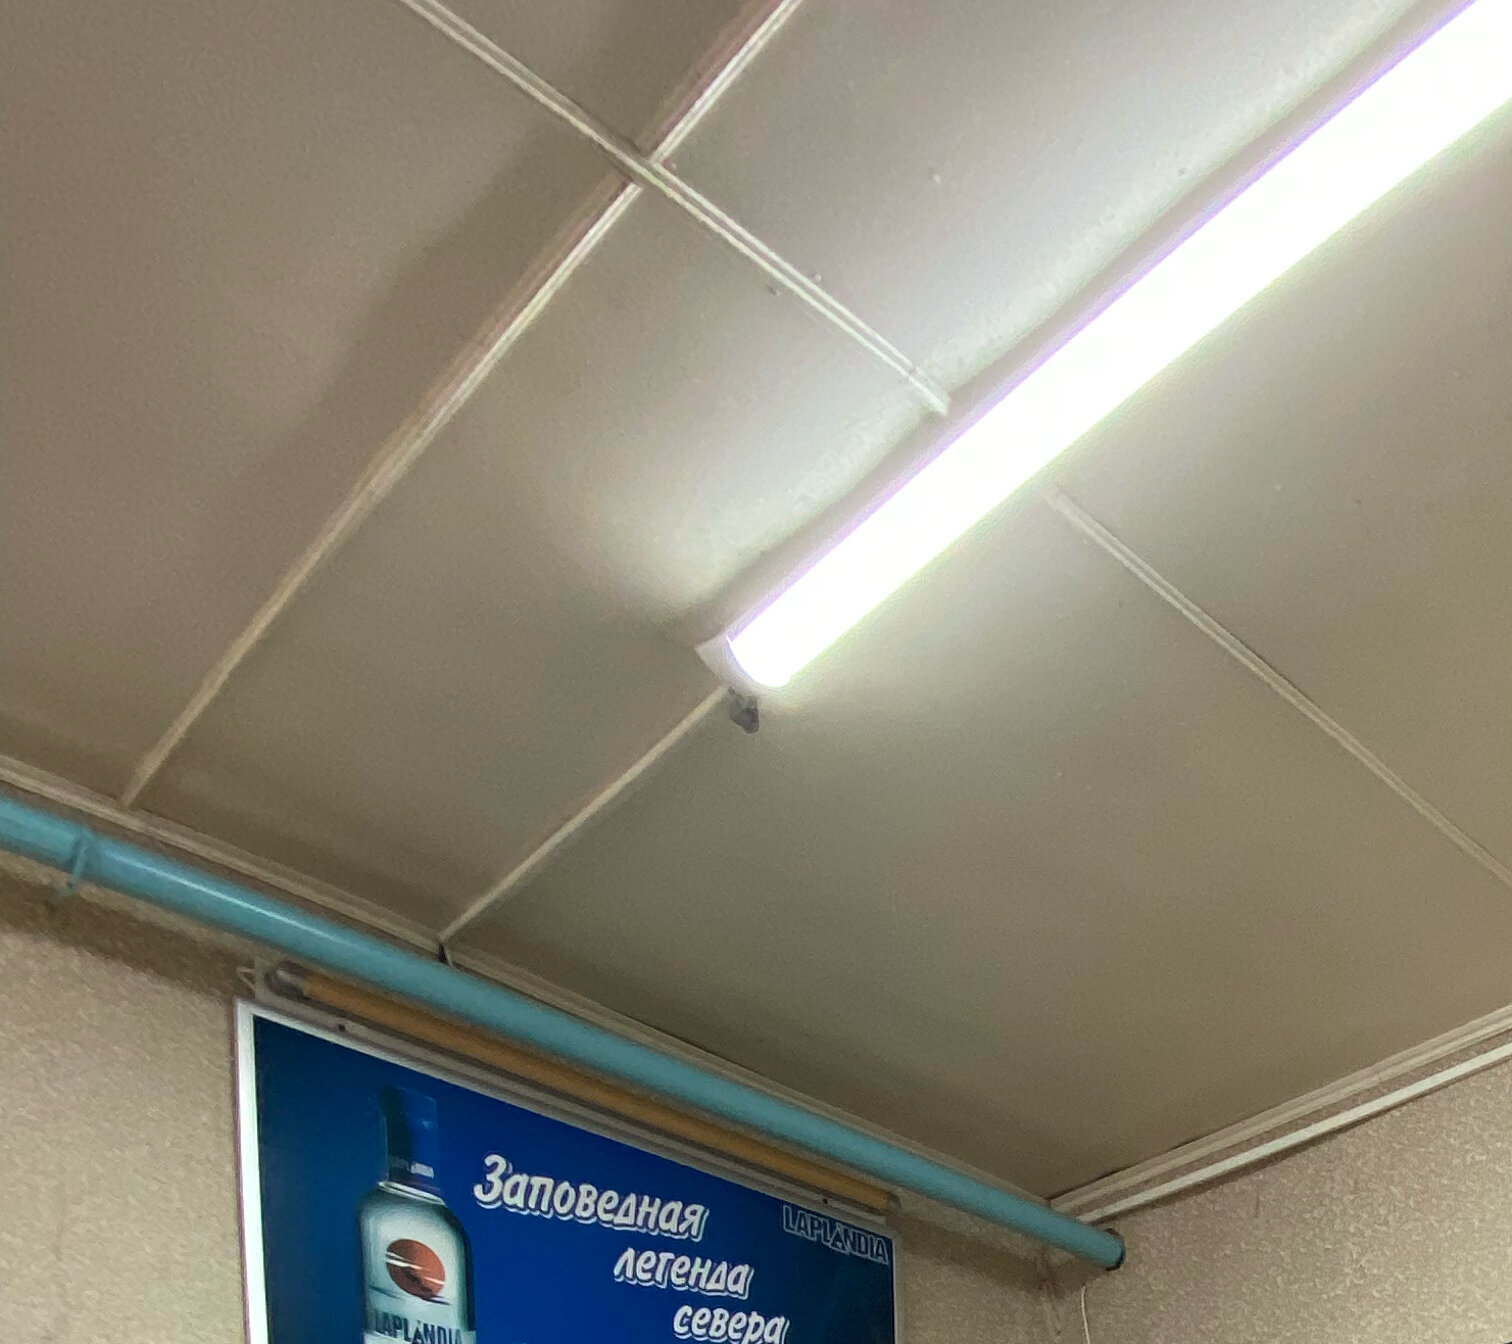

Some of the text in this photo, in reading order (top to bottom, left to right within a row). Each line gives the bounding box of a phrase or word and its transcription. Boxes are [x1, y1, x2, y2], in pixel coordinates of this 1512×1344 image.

[473, 1153, 708, 1242] Заповедная
[782, 1204, 890, 1265] LAPLANDIA
[614, 1247, 754, 1299] легенда
